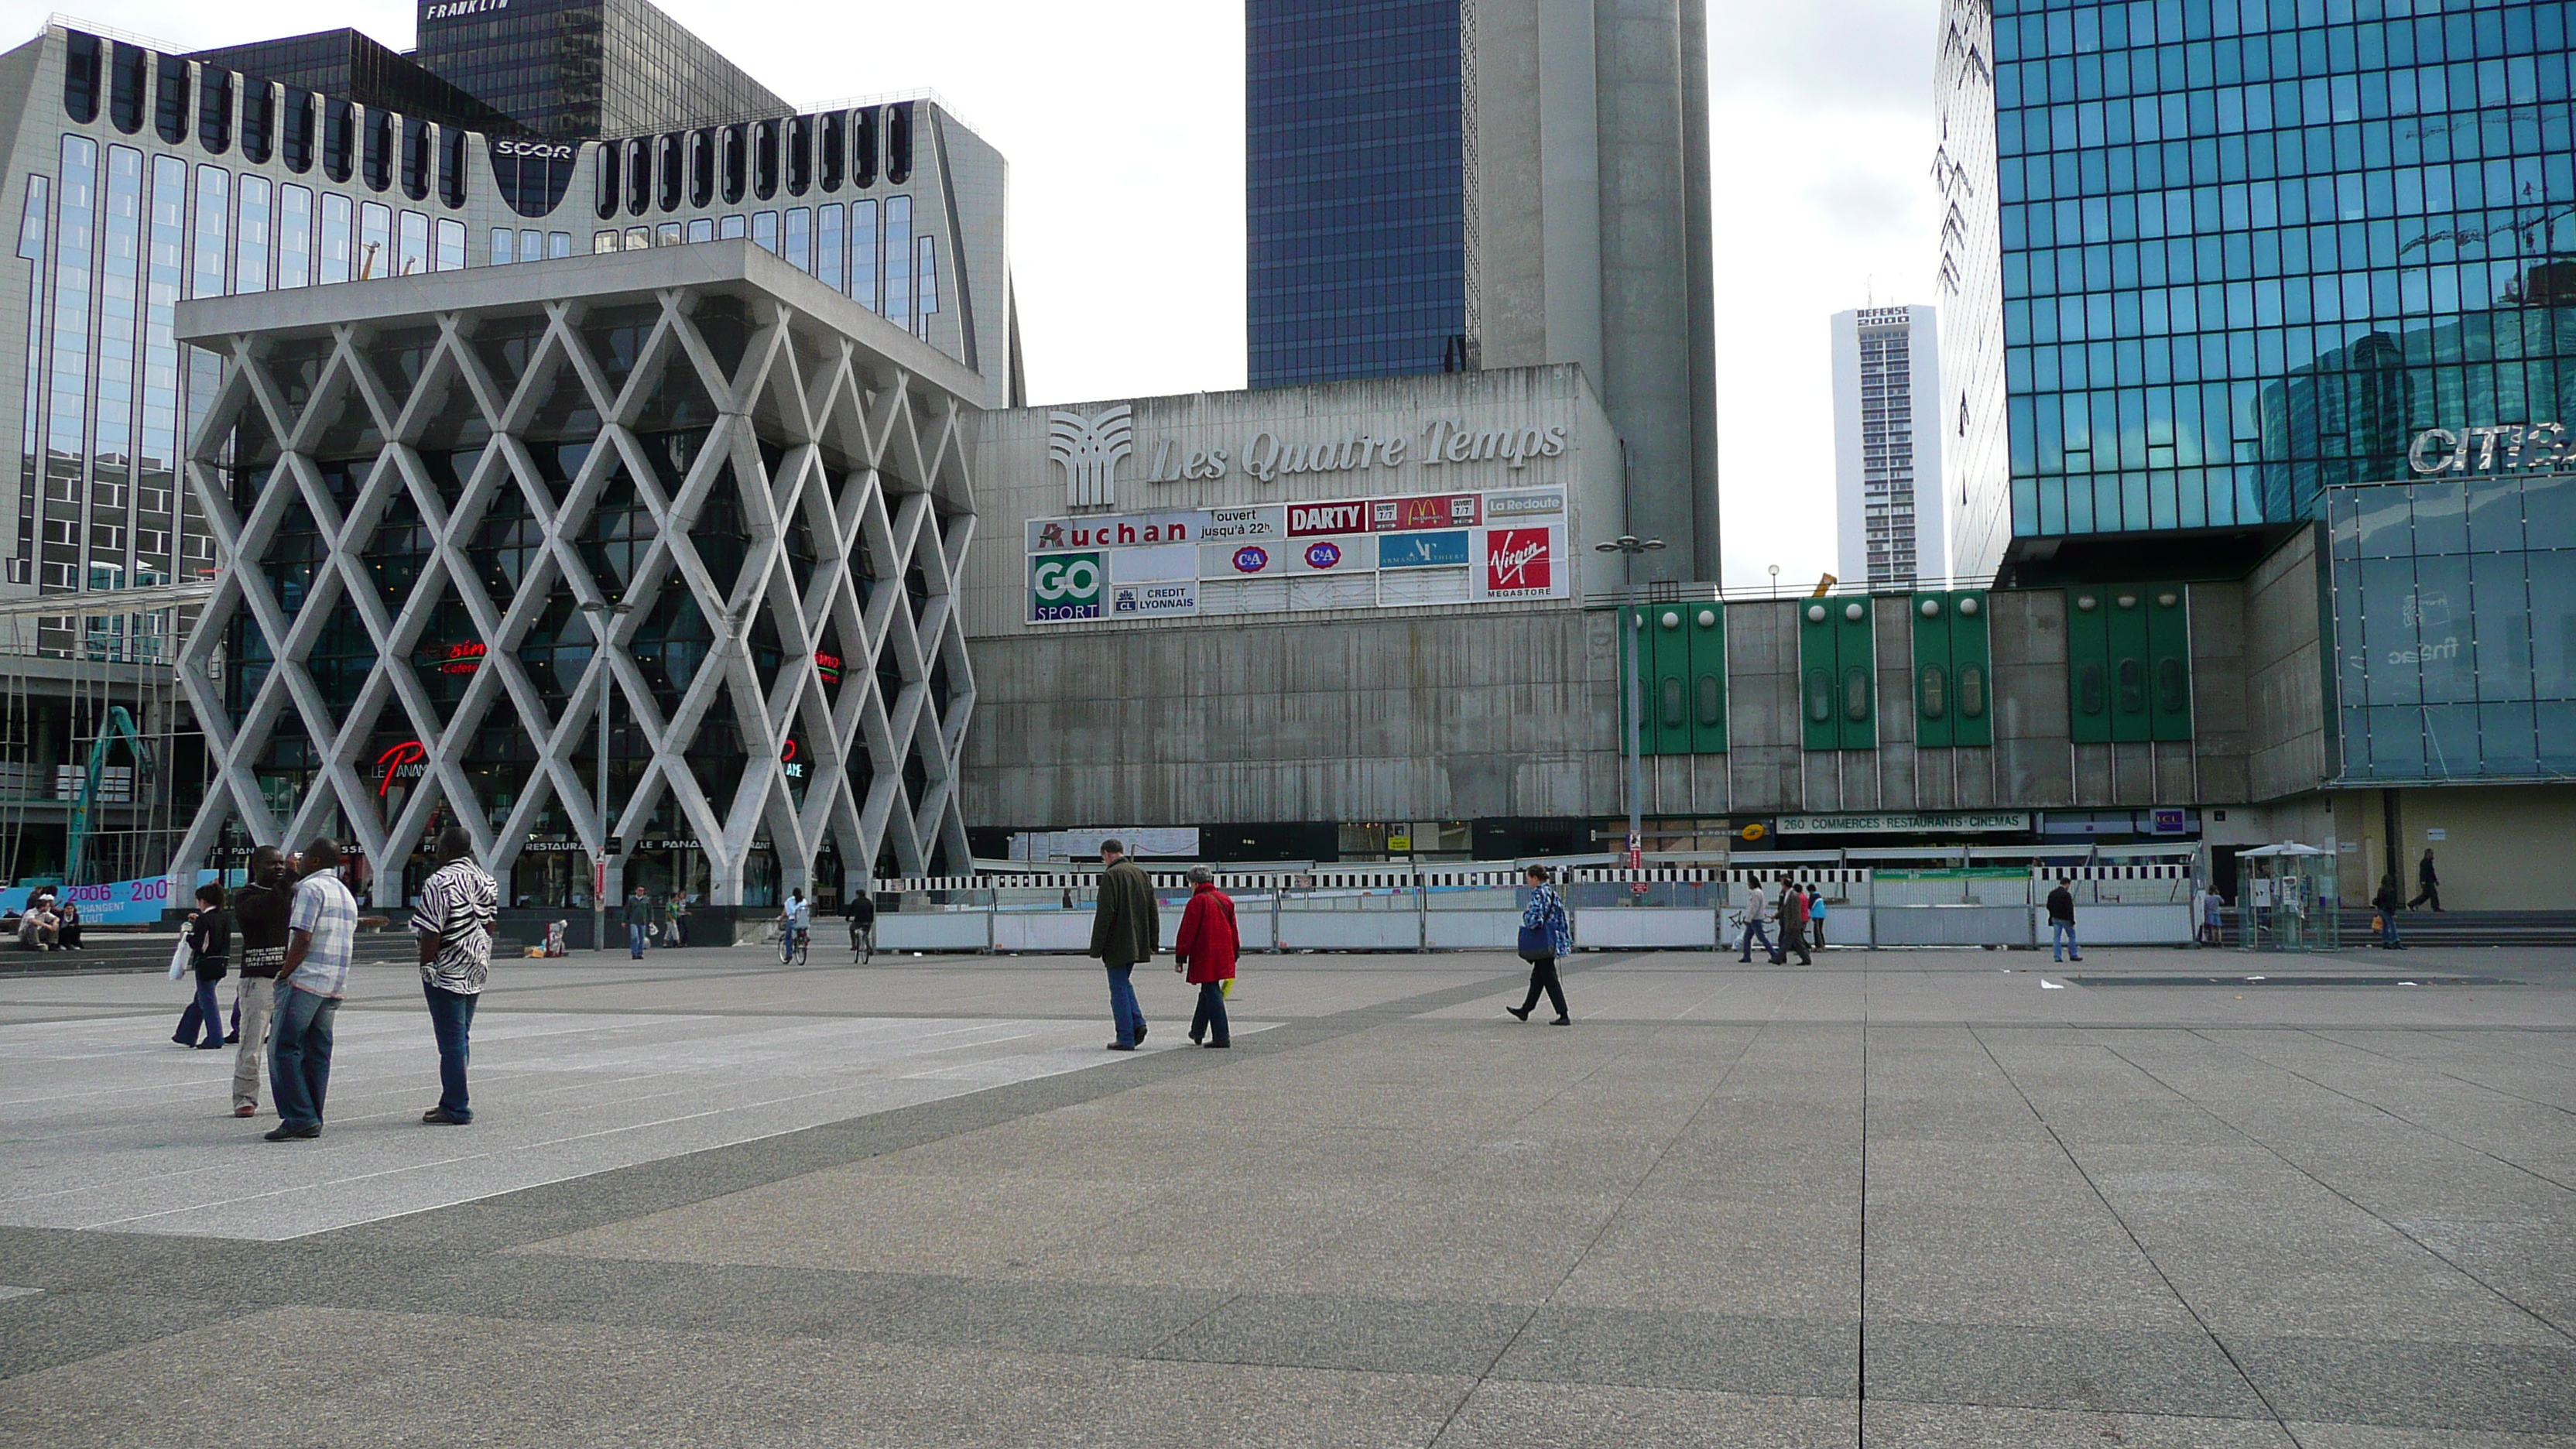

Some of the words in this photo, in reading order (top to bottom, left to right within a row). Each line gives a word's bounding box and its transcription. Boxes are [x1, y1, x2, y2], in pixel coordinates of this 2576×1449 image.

[426, 0, 509, 20] FRANKLIN
[496, 140, 572, 159] SCOR
[1857, 306, 1910, 318] DEFENSE
[1858, 316, 1910, 326] 2000
[1146, 437, 1228, 483] Les
[1242, 428, 1407, 483] Quatre
[1420, 418, 1567, 469] Temps
[1491, 501, 1505, 512] La
[1507, 498, 1560, 510] Redoute
[1217, 509, 1256, 522] ouvert
[1292, 505, 1361, 531] DARTY
[1039, 522, 1187, 548] Auchan
[1201, 524, 1245, 540] jusqu'à
[1238, 553, 1262, 566] C&A
[1310, 549, 1336, 562] C&A
[1382, 556, 1419, 564] ARMAND
[1490, 531, 1547, 585] Virgin
[1035, 560, 1100, 600] GO
[1147, 587, 1186, 598] CREDIT
[1488, 587, 1552, 598] MEGASTORE
[1119, 602, 1132, 611] CL
[1139, 598, 1194, 609] LYONNAIS
[1037, 604, 1098, 621] SPORT
[1784, 819, 1804, 831] 260
[1812, 817, 1880, 830] COMMERCES
[1887, 816, 1962, 829] RESTAURANTS
[1970, 815, 2019, 827] CINEMAS
[67, 884, 111, 903] 2006
